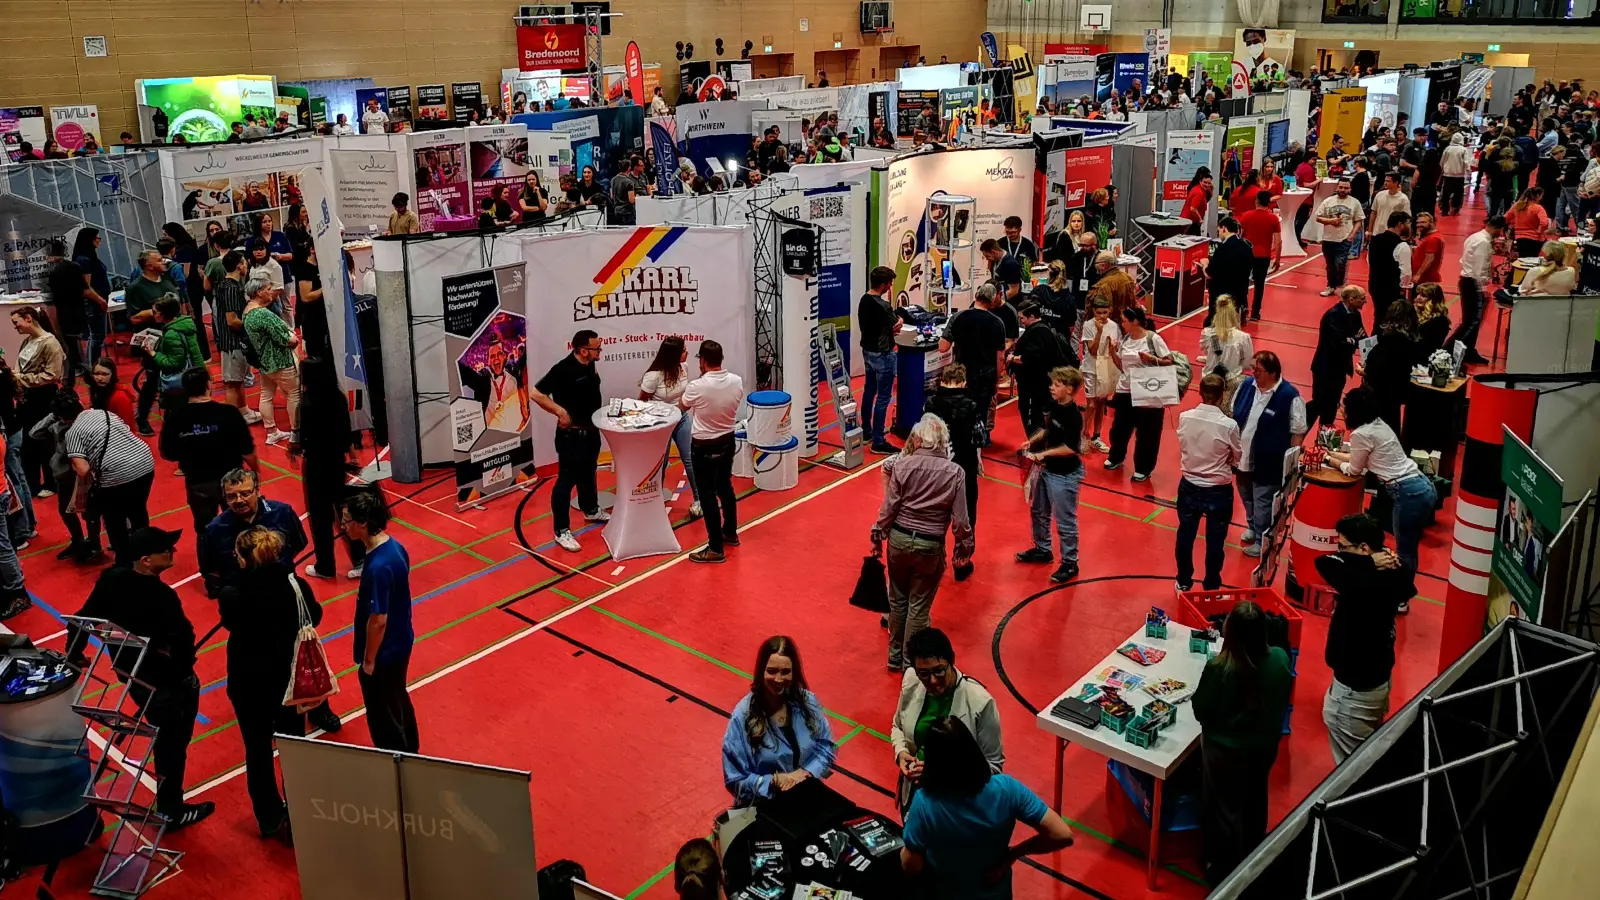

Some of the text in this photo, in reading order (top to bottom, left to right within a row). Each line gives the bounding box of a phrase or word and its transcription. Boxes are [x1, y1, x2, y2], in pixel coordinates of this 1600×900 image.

[525, 48, 580, 59] Bredenoord
[268, 148, 309, 159] GEMEINSCHAFTEN
[985, 163, 1013, 176] MEKRA
[1067, 187, 1084, 202] WE
[62, 200, 90, 212] FÜRST
[98, 196, 137, 207] PARTNER
[16, 235, 68, 252] PARTNER
[446, 279, 494, 293] Wir unterstützen
[621, 266, 699, 293] KARL
[447, 290, 482, 302] Nachwuchs-
[448, 298, 479, 312] förderung!
[573, 290, 699, 322] SCHMIDT
[803, 295, 819, 322] im
[625, 333, 648, 343] Stuck
[804, 325, 819, 449] Willkommen
[482, 454, 511, 469] MITGLIED
